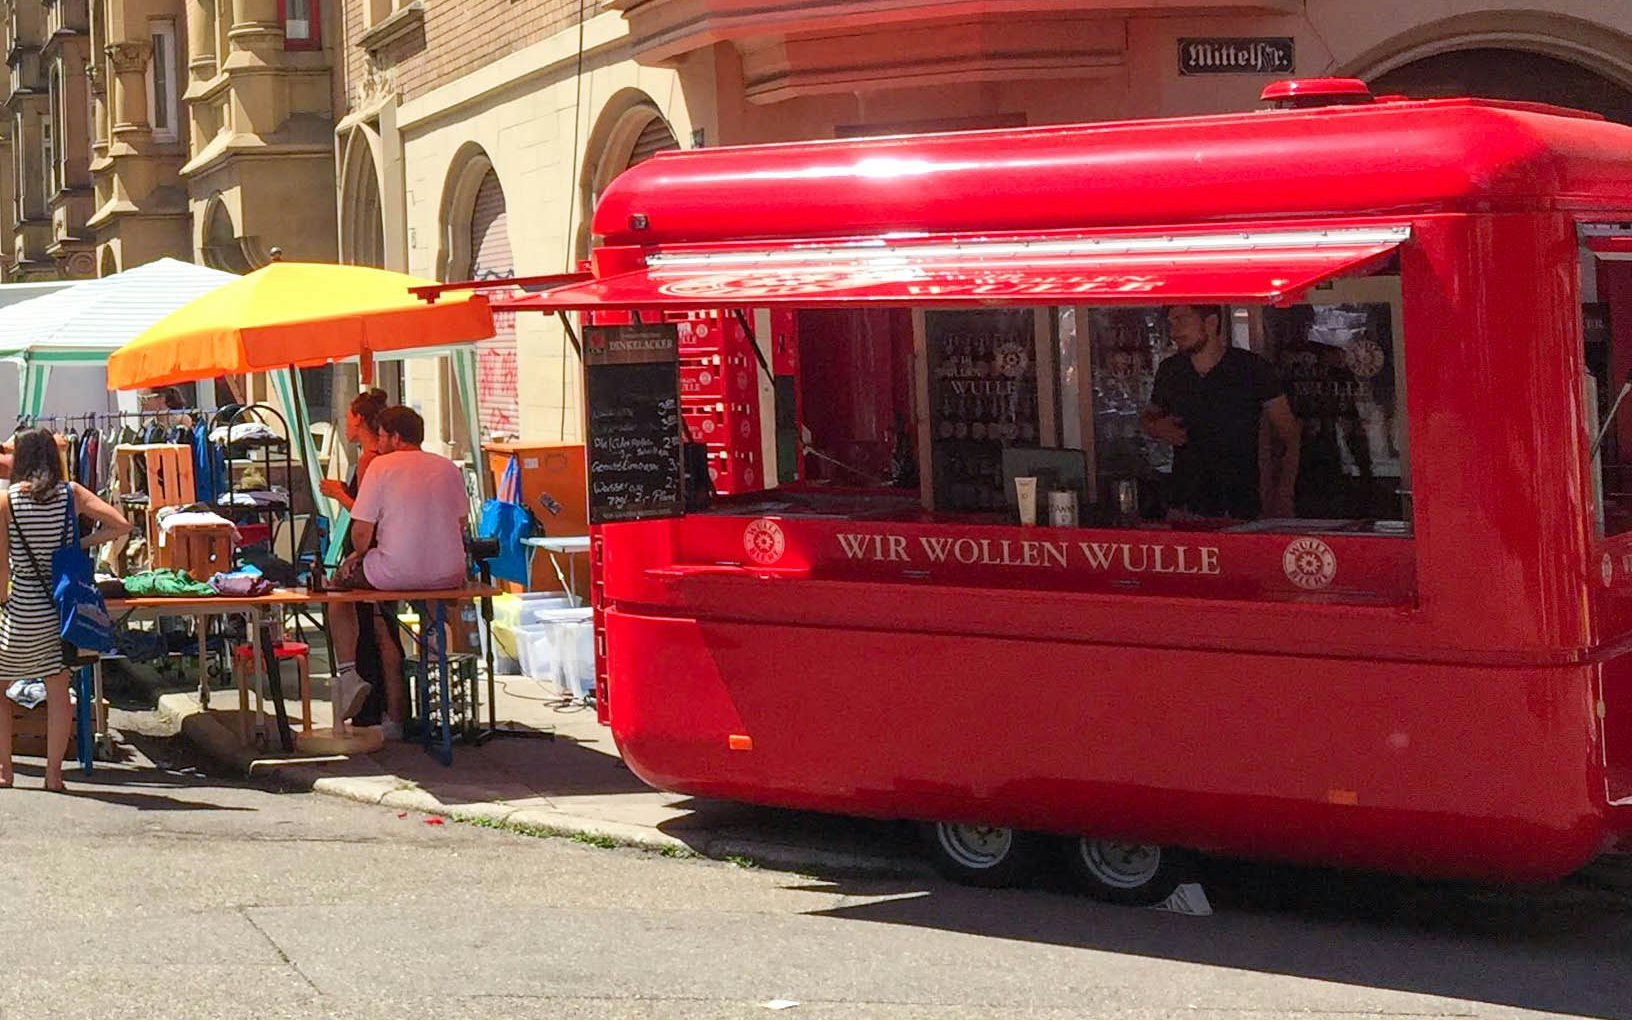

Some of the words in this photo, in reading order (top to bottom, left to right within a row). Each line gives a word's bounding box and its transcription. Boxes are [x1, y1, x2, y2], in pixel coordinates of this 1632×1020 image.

[836, 533, 911, 562] WIR
[919, 536, 1069, 568] WOLLEN
[1078, 541, 1221, 575] WULLE
